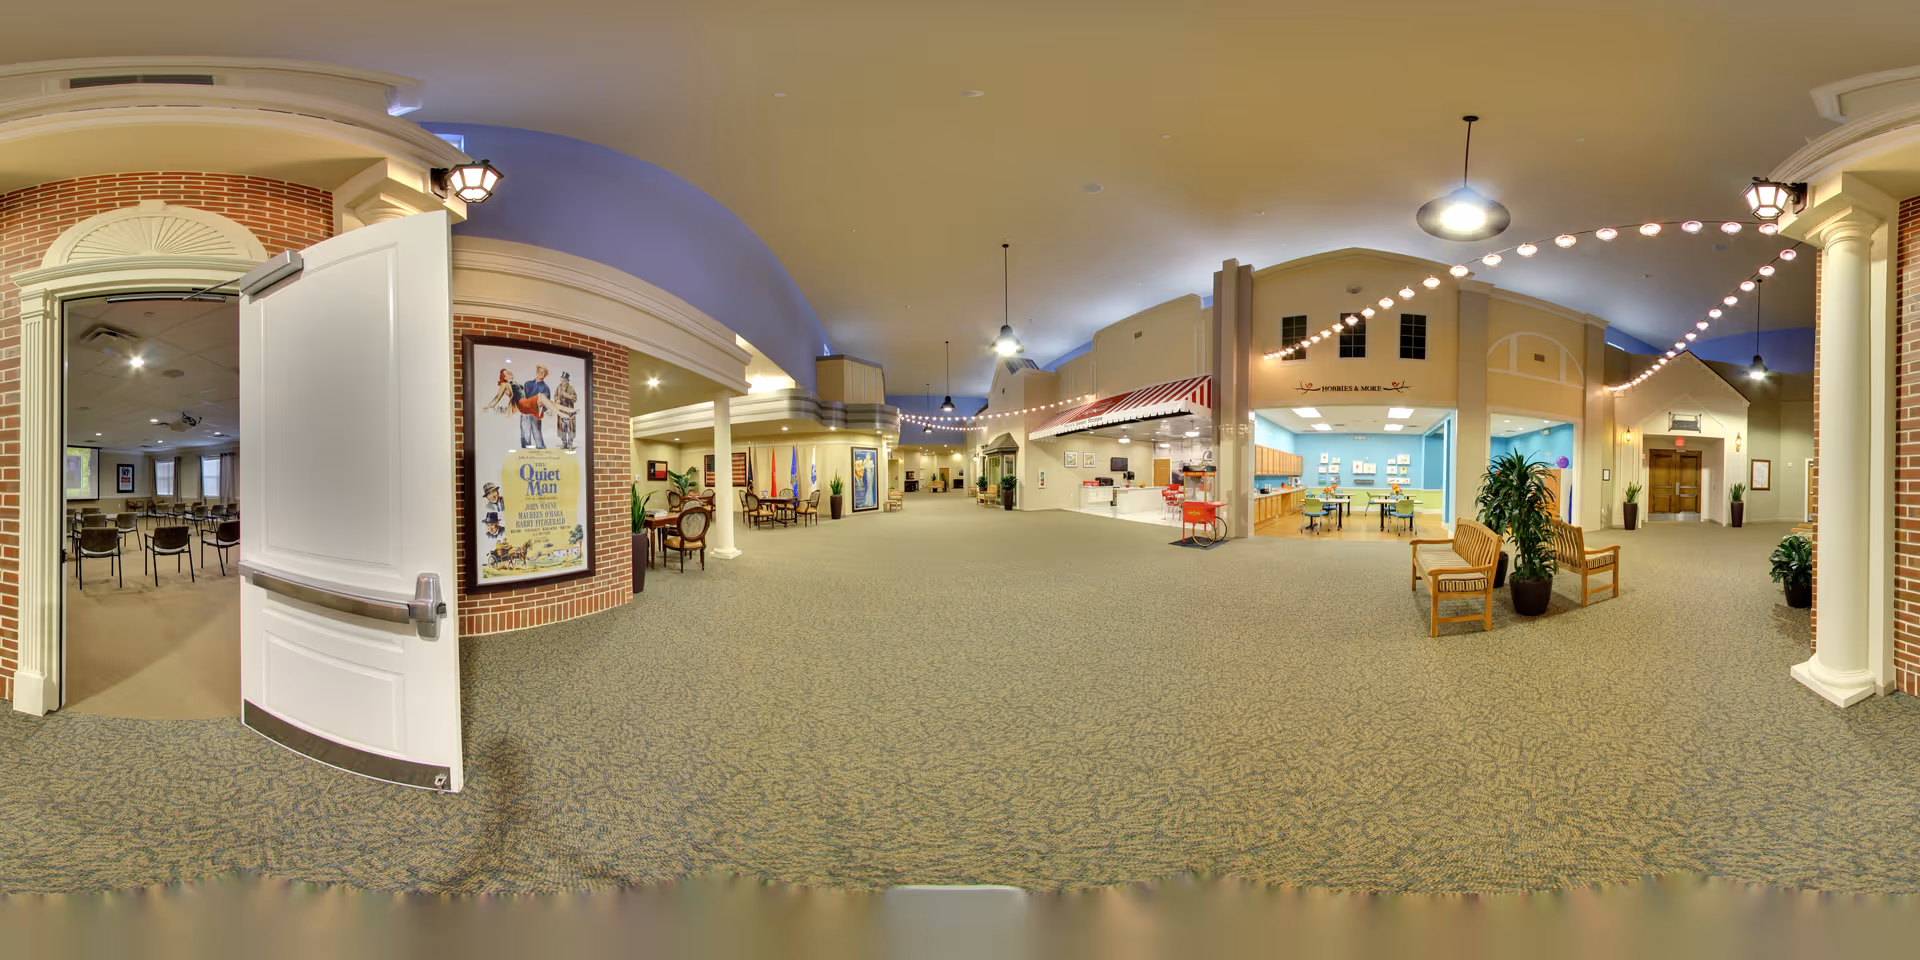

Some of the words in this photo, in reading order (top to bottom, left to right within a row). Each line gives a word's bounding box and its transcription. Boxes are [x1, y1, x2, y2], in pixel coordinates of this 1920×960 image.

[520, 464, 560, 481] Quiet
[525, 481, 558, 496] Man
[525, 503, 539, 511] JOHN
[540, 502, 557, 510] WAYNE
[518, 510, 544, 520] MAUREEN
[515, 519, 534, 528] BARRY
[535, 517, 566, 527] FITZGERALD
